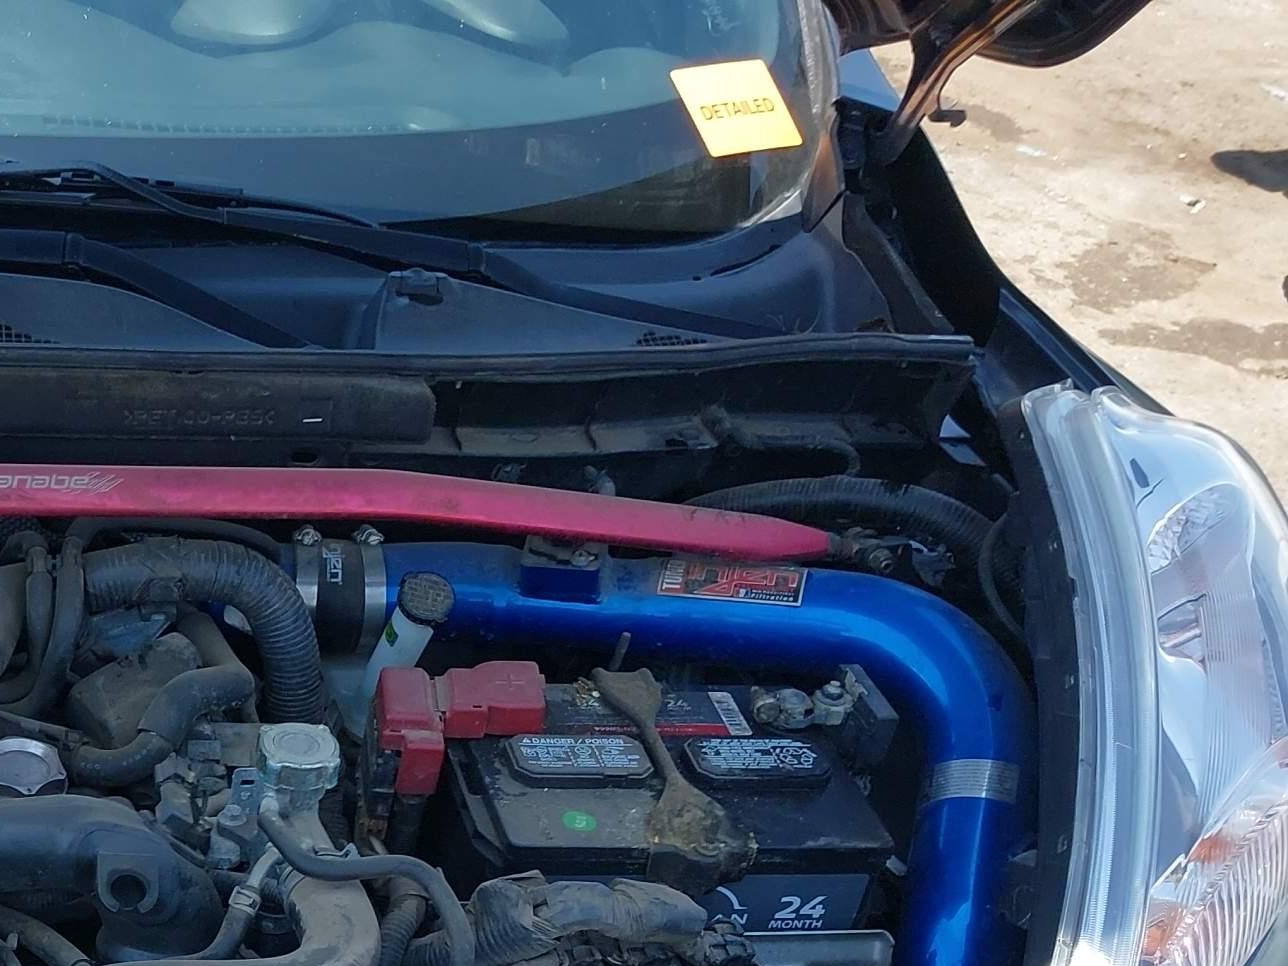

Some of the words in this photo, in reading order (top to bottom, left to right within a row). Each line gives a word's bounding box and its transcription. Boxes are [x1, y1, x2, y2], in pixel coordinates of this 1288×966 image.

[699, 97, 776, 121] DETAILED
[532, 737, 574, 745] DANGER
[585, 737, 624, 745] POISON
[773, 895, 829, 919] 24
[768, 919, 823, 929] MONTH
